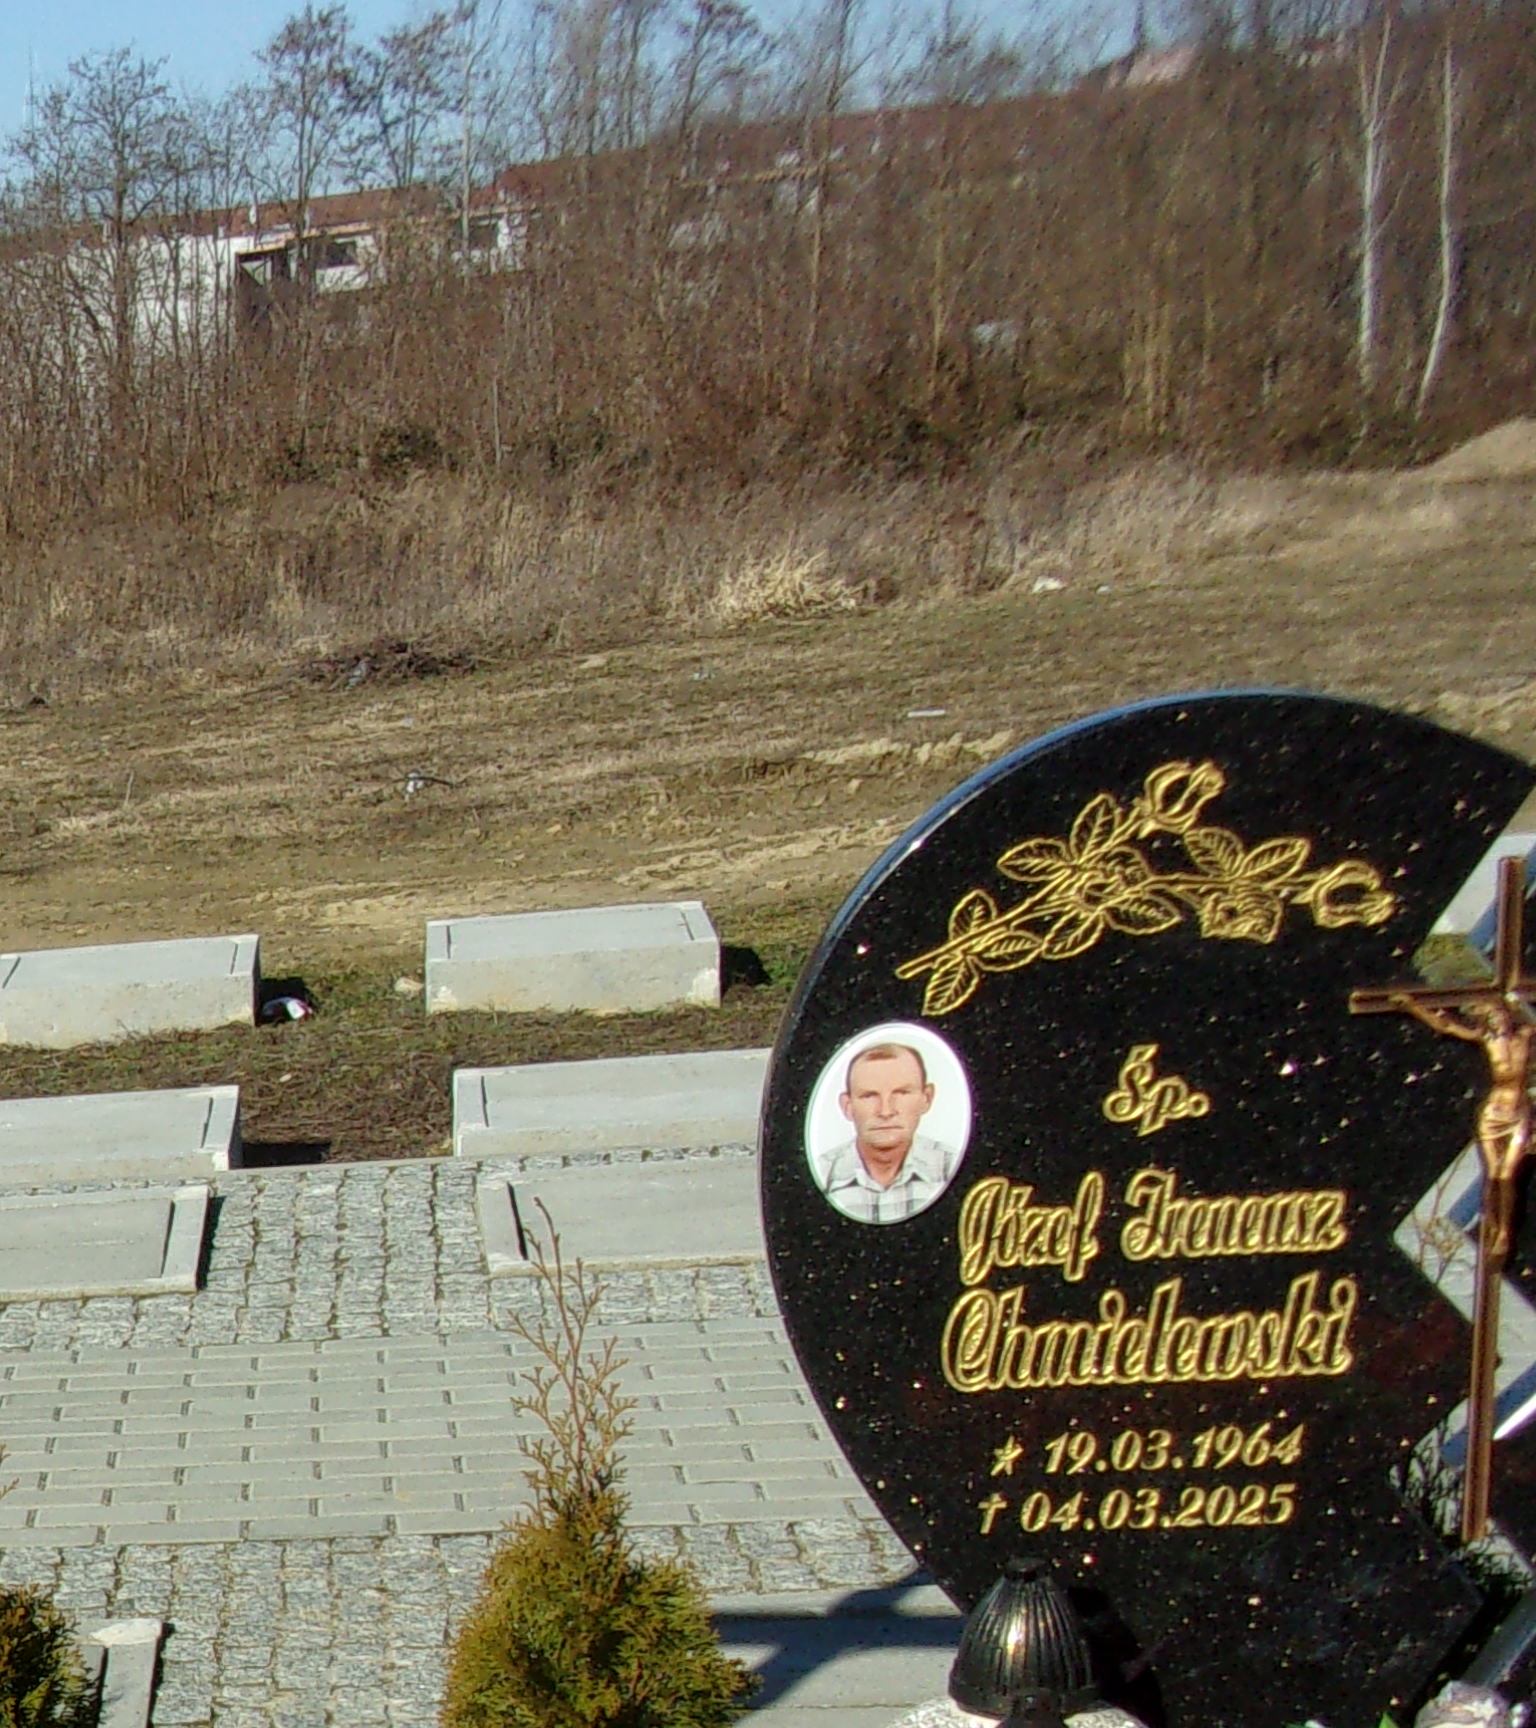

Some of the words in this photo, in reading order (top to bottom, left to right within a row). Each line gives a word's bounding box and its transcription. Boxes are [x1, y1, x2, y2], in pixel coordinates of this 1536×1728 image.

[957, 1172, 1107, 1286] Józef
[1121, 1170, 1347, 1261] Ireneusz
[940, 1274, 1357, 1393] Chmielewski
[1043, 1422, 1303, 1477] 19.03.1964
[1019, 1482, 1295, 1535] 04.03.2025
